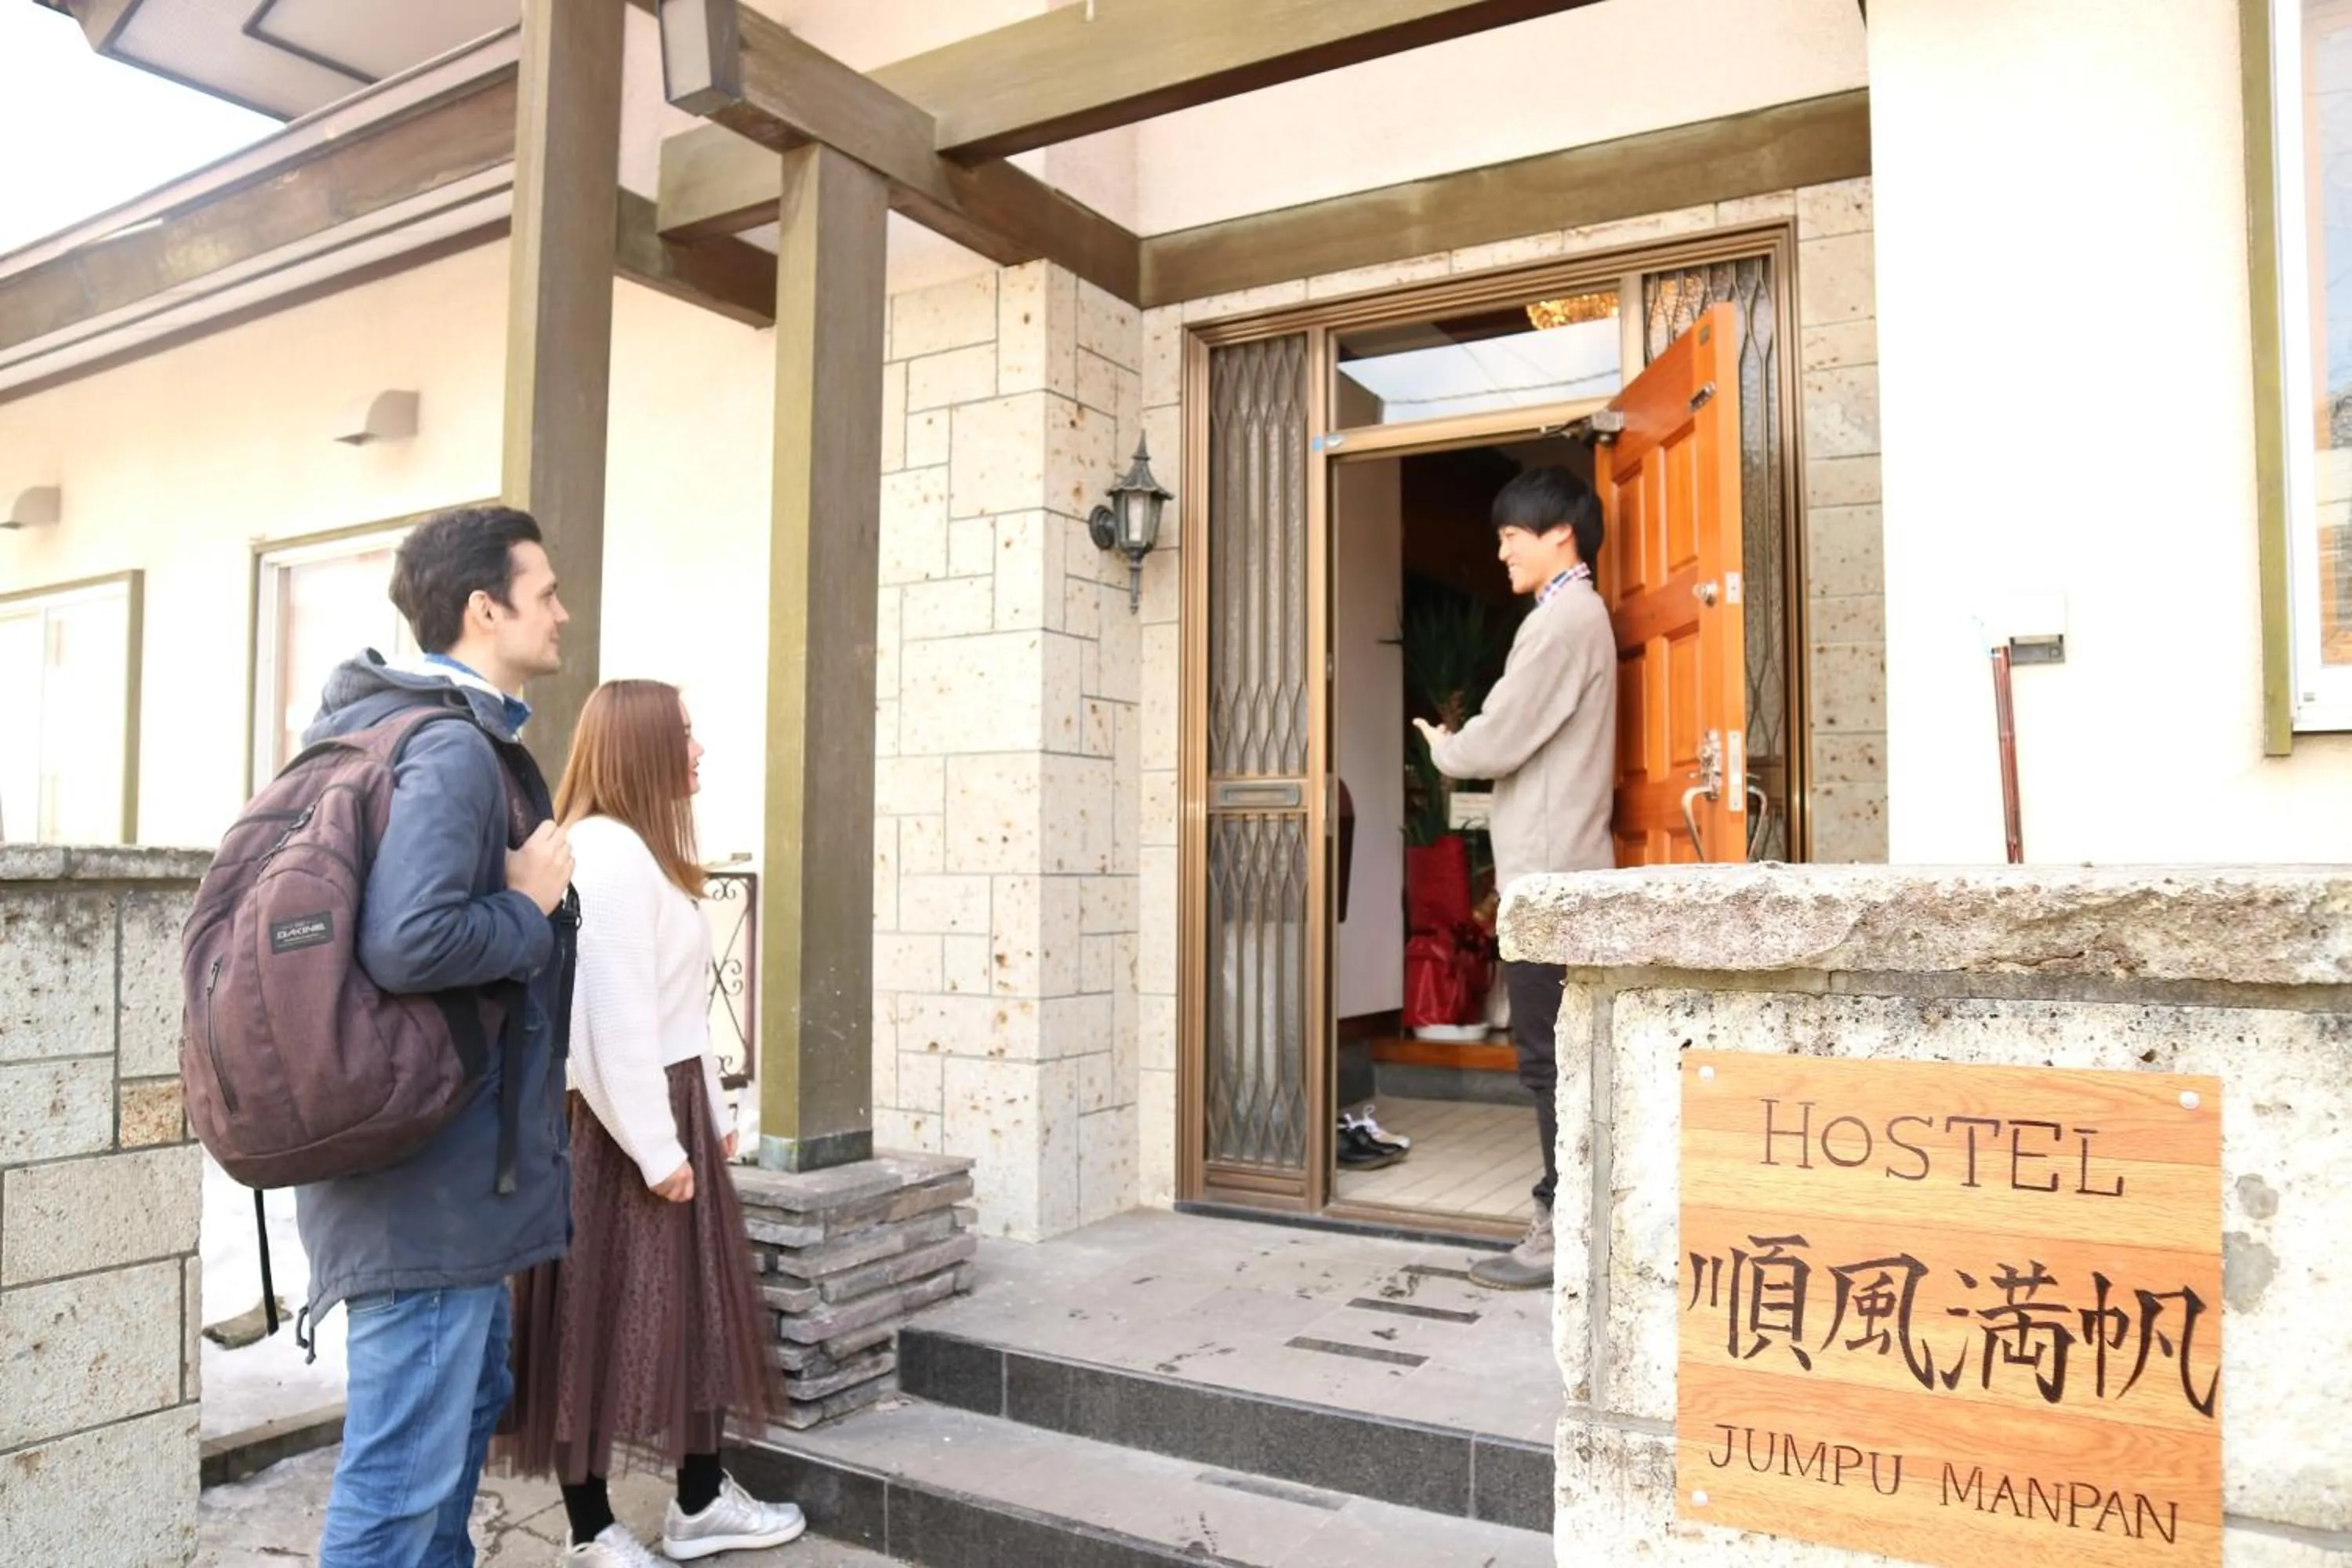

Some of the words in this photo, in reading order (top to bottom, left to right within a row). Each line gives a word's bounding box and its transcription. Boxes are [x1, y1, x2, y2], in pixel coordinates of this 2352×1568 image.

[1759, 1098, 2125, 1197] HOSTEL
[1687, 1234, 2220, 1418] 順風満帆
[1708, 1424, 1903, 1496] JUMPU
[1939, 1462, 2178, 1544] MANPAN
